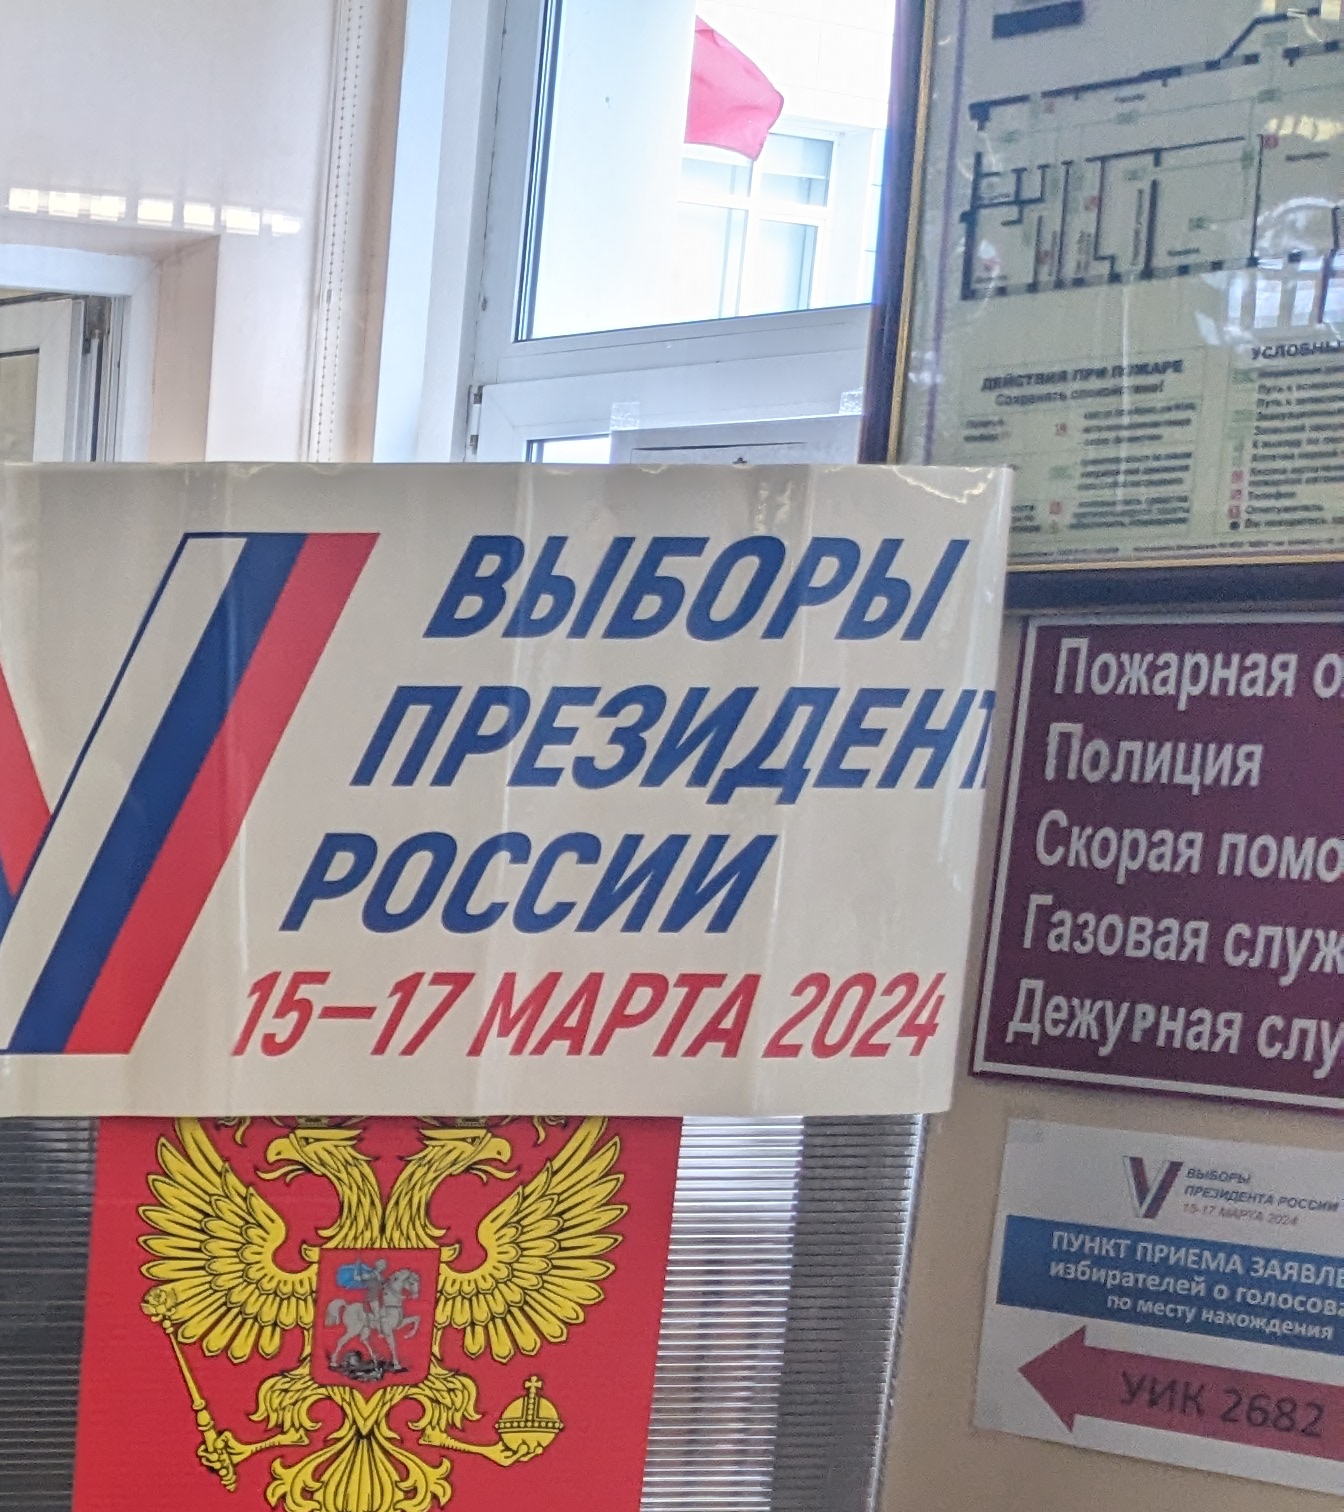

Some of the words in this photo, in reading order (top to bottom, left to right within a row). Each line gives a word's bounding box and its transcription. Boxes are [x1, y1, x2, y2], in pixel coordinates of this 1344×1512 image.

[422, 535, 969, 640] ВЫБОРЫ
[1054, 637, 1297, 711] Пожарная
[1313, 653, 1344, 699] о
[350, 685, 997, 805] ПРЕЗИДЕНТ
[1045, 722, 1263, 795] Полиция
[280, 832, 776, 933] РОССИИ
[1035, 809, 1203, 885] Скорая
[1217, 832, 1344, 883] помо
[1022, 894, 1209, 963] Газовая
[1223, 922, 1344, 987] служ
[467, 971, 763, 1059] МАРТА
[761, 971, 946, 1059] 2024
[1005, 978, 1243, 1057] Дежурная
[1257, 1014, 1344, 1080] слу
[1184, 1185, 1274, 1207] ПРЕЗИДЕНТА
[1277, 1195, 1340, 1213] РОССИИ
[1185, 1167, 1252, 1185] ВЫБОРЫ
[1218, 1205, 1263, 1222] МАРТА
[1268, 1212, 1300, 1227] 2024
[1049, 1259, 1207, 1298] избирателей
[1213, 1283, 1229, 1301] о
[1051, 1230, 1132, 1260] ПУНКТ
[1135, 1241, 1246, 1275] ПРИЕМА
[1249, 1256, 1344, 1289] ЗАЯВЛЕ
[1106, 1294, 1131, 1311] по
[1136, 1298, 1197, 1324] месту
[1201, 1307, 1335, 1341] нахождения
[1120, 1370, 1207, 1418] УИК
[1219, 1387, 1326, 1439] 2682
